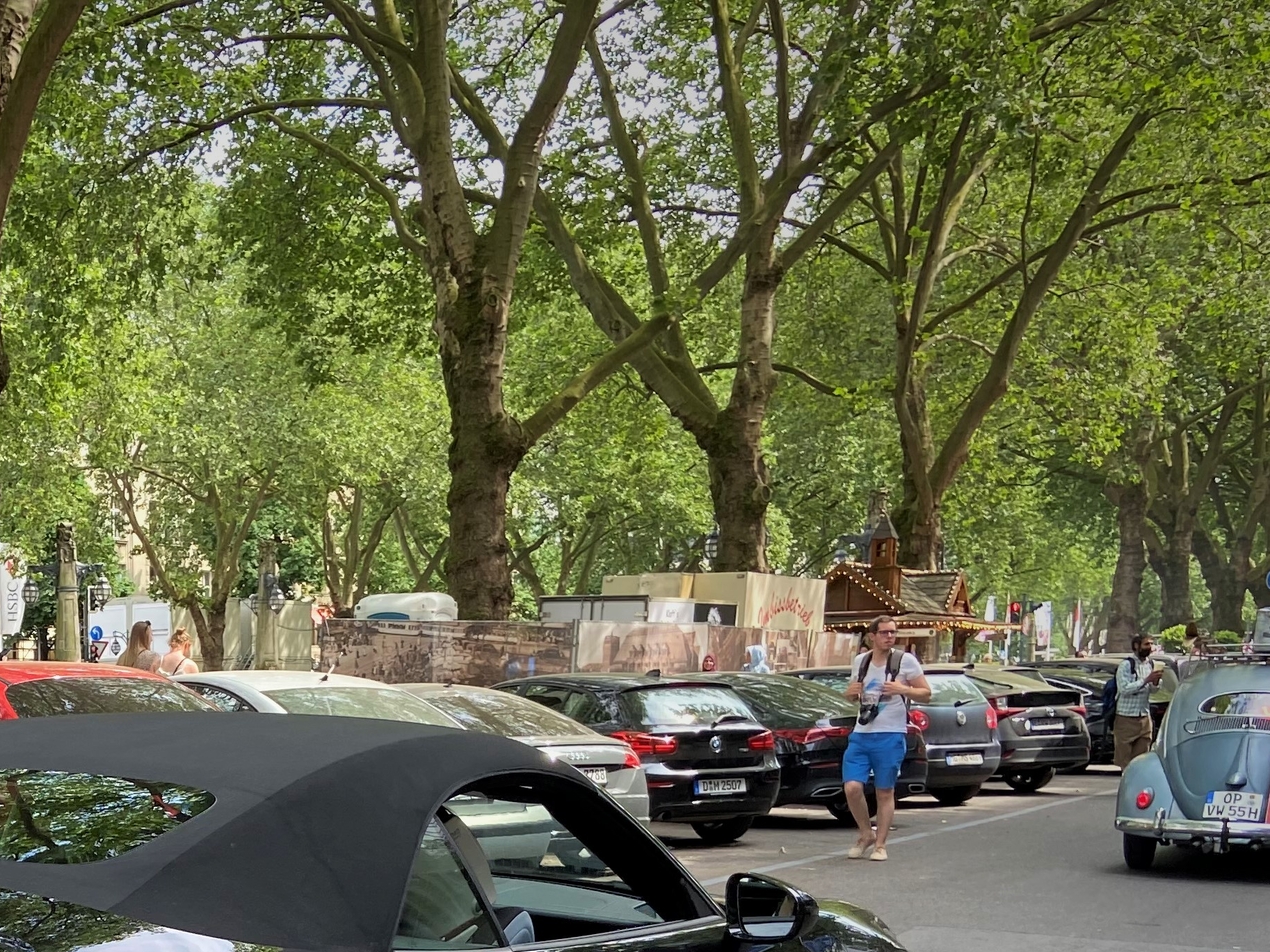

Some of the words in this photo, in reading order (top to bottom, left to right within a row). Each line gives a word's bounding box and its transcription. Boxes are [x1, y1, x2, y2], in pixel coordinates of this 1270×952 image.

[7, 581, 18, 622] HSBC
[721, 780, 742, 790] 2507
[1223, 792, 1242, 804] OP
[1207, 805, 1225, 816] VW
